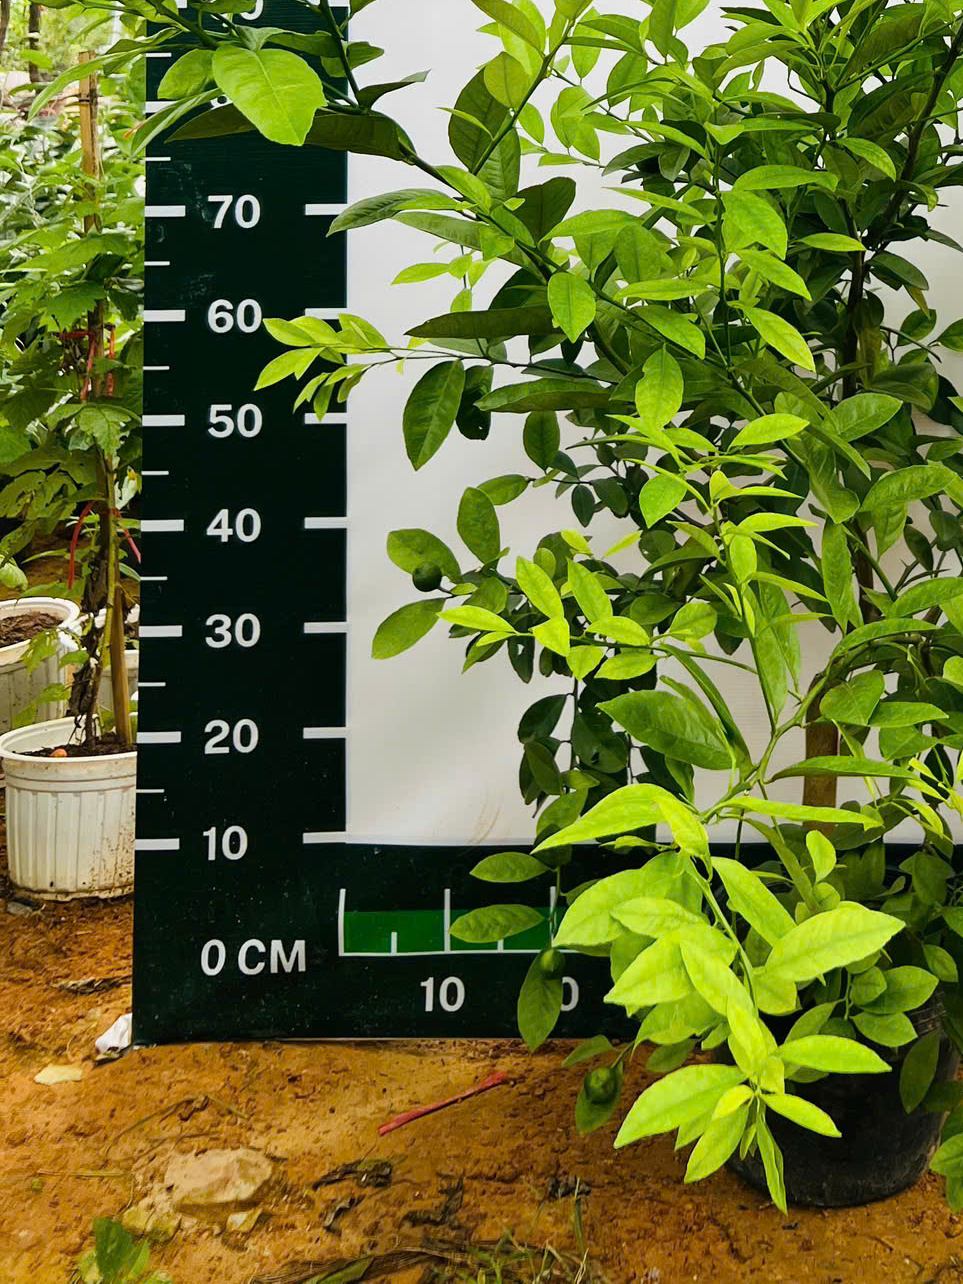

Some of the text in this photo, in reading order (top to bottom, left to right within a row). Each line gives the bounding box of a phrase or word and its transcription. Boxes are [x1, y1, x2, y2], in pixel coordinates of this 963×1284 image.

[208, 194, 260, 229] 70
[207, 298, 262, 333] 60
[207, 403, 262, 438] 50
[206, 508, 261, 543] 40
[205, 613, 260, 648] 30
[204, 719, 258, 754] 20
[202, 825, 248, 861] 10
[201, 938, 306, 976] 0 CM
[419, 976, 465, 1012] 10
